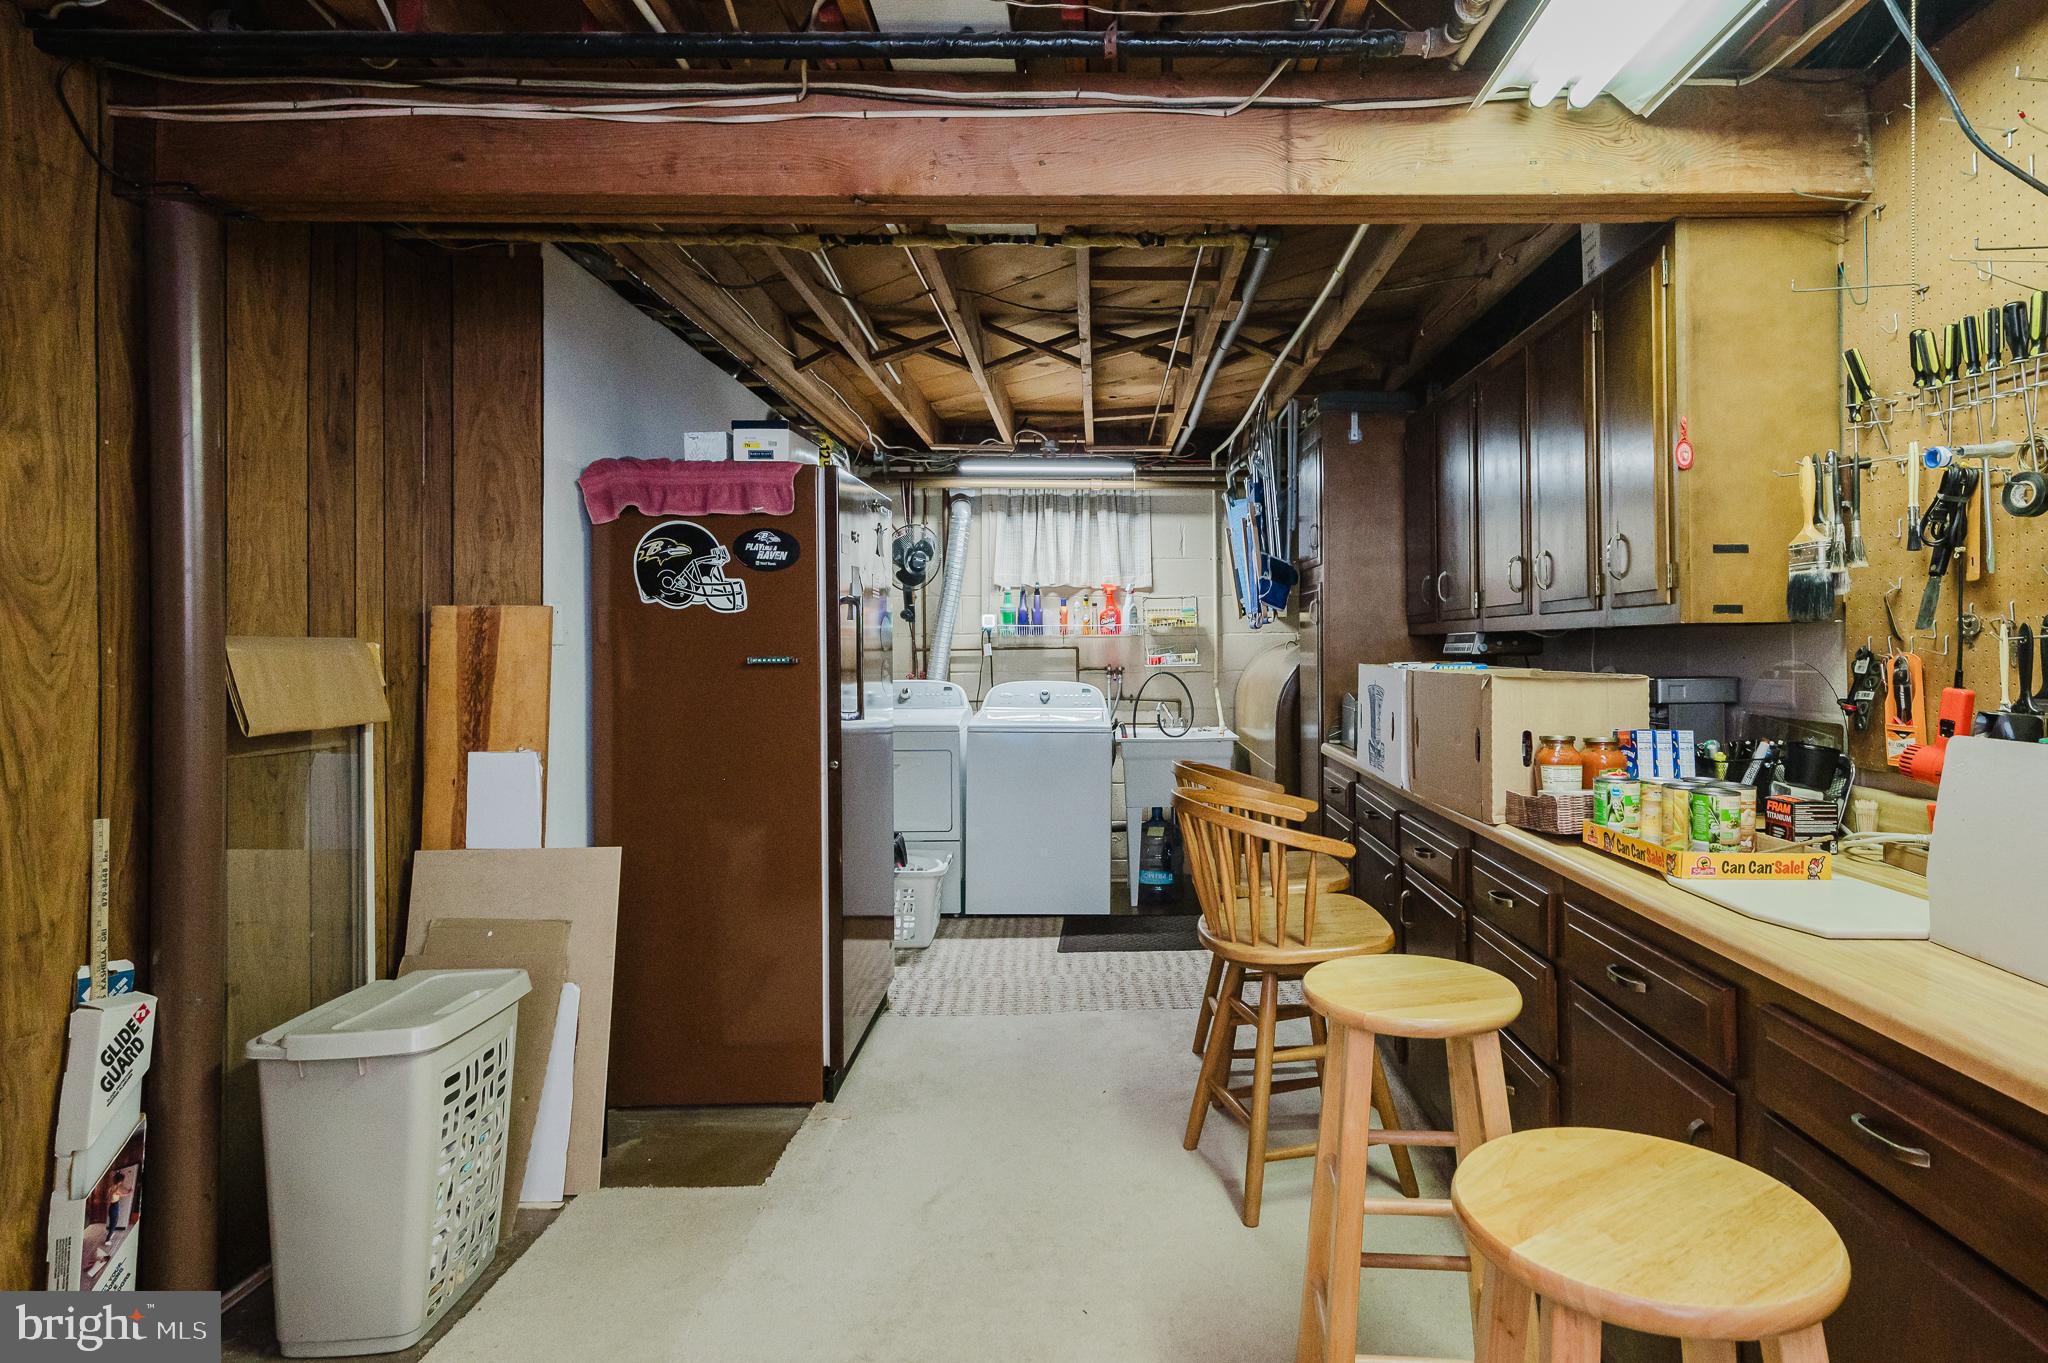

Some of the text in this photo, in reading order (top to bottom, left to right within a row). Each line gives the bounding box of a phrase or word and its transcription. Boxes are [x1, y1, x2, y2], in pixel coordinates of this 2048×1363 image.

[745, 543, 764, 551] PLAY
[757, 551, 788, 561] RAVEN
[1766, 800, 1792, 815] FRAM
[1766, 811, 1792, 823] TITANIUM
[1616, 839, 1630, 856] Can
[1631, 844, 1646, 862] Can
[1646, 847, 1665, 868] Sale!
[1721, 860, 1746, 875] Can
[1748, 860, 1773, 875] Can
[1775, 860, 1805, 875] Sale!
[100, 1017, 140, 1067] GLIDE
[100, 1037, 145, 1092] GUARD
